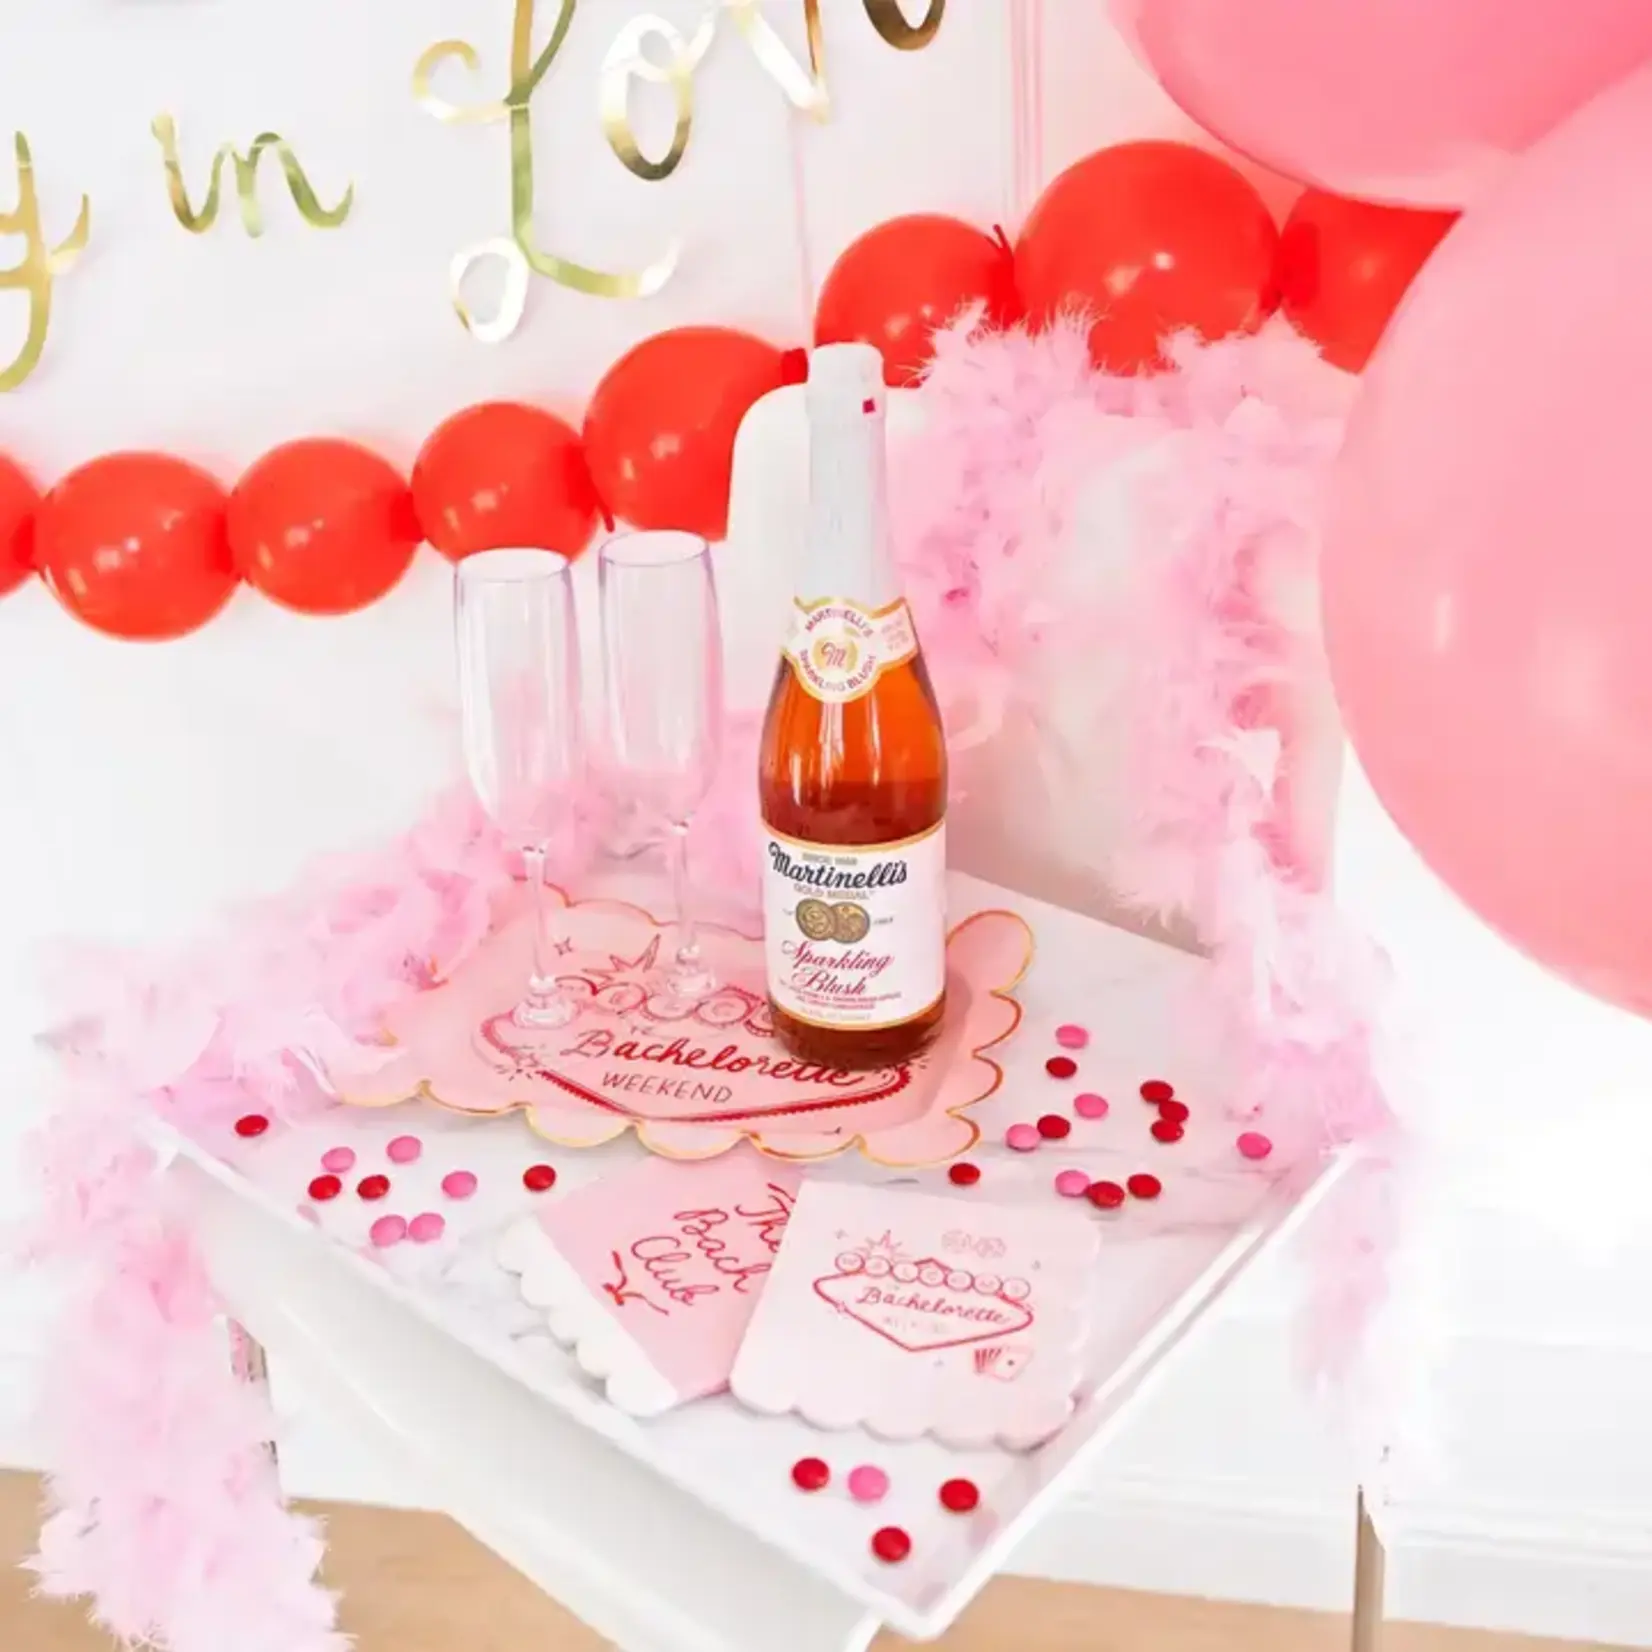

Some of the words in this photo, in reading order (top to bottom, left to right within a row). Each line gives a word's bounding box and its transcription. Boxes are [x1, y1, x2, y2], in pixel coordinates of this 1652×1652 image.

[151, 113, 354, 238] in
[412, 0, 945, 342] Lov
[781, 940, 894, 977] Sparkling
[791, 967, 868, 996] Blush
[602, 1070, 733, 1105] WEEKEND
[673, 1208, 772, 1293] Bach
[631, 1236, 720, 1306] Club
[855, 1286, 1010, 1325] Bachelorette
